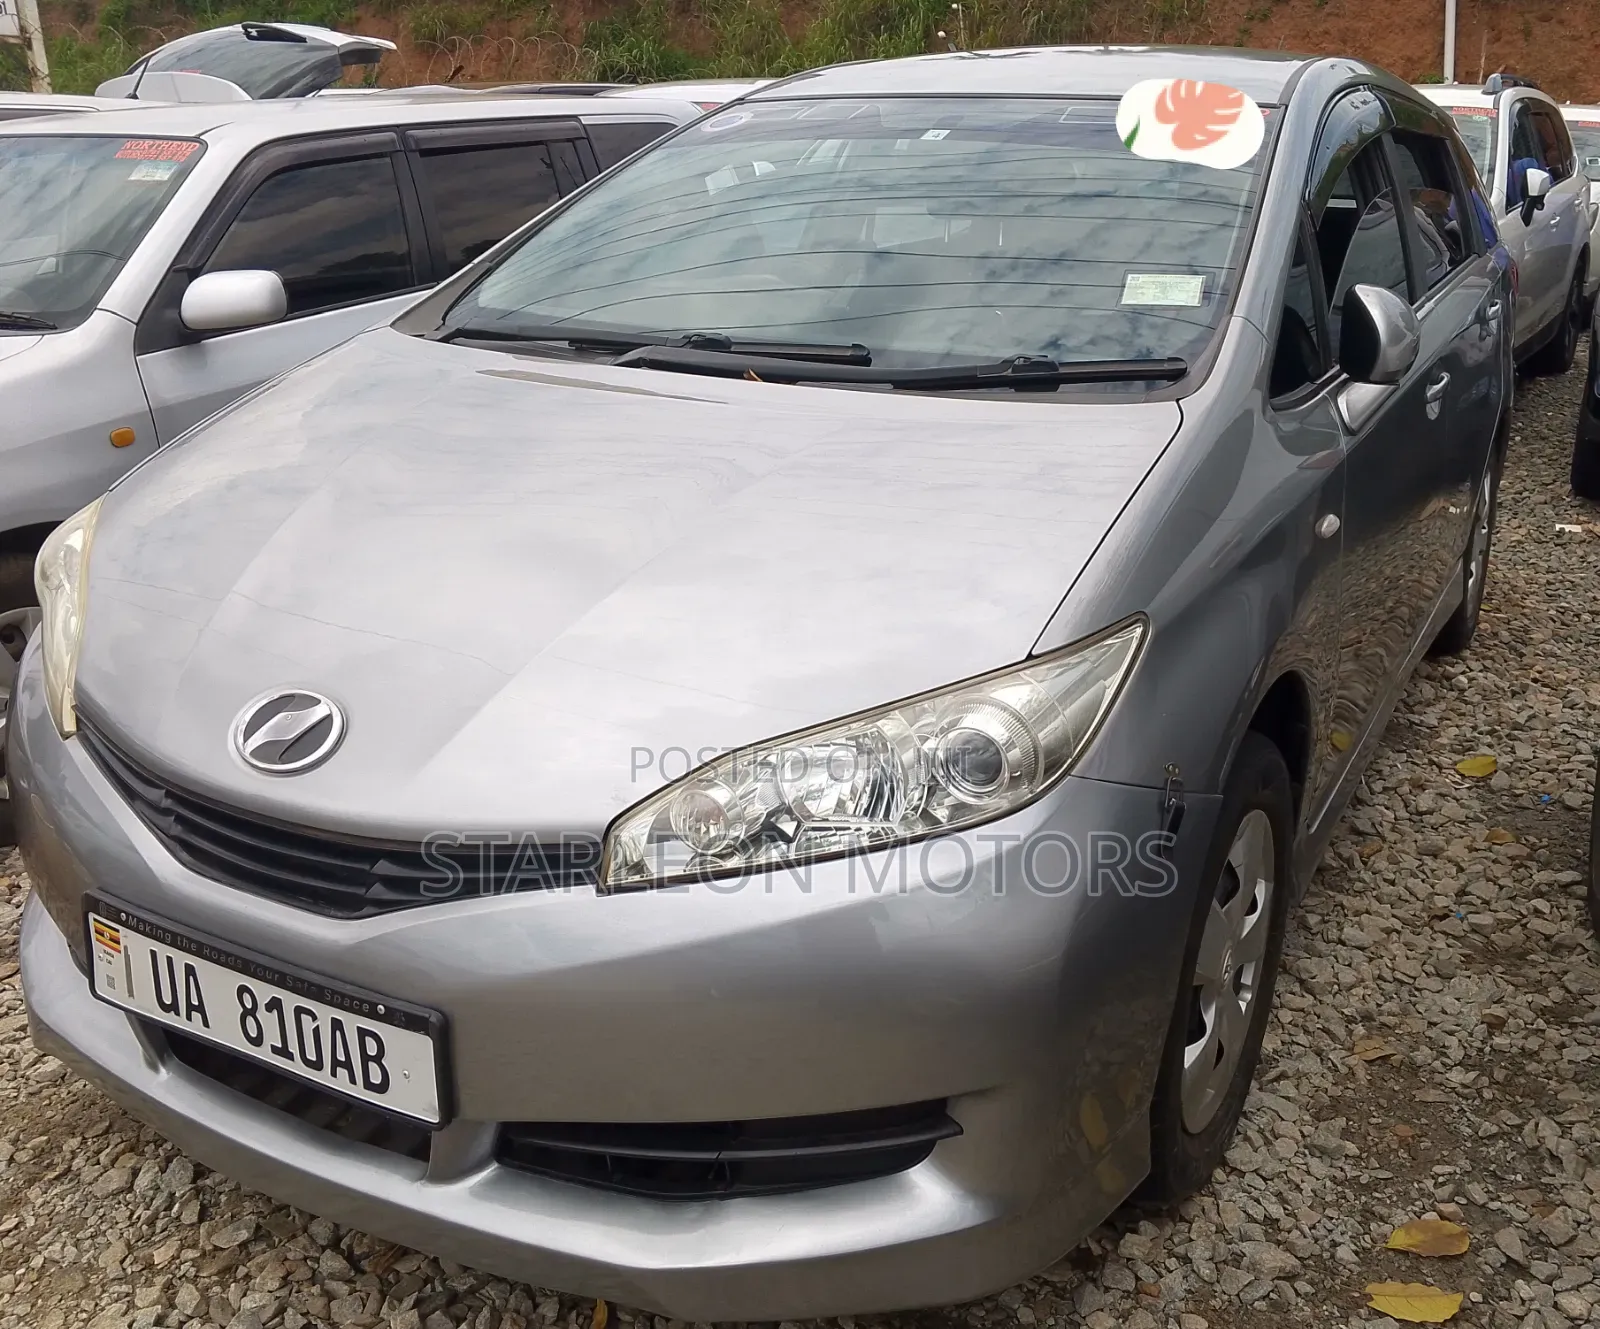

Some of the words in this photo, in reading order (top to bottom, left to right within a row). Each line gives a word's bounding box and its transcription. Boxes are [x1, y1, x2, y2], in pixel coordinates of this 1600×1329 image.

[121, 140, 199, 152] NORTHEND
[128, 915, 171, 943] Making
[177, 935, 197, 951] the
[202, 944, 242, 969] Roads
[250, 964, 280, 982] Your
[324, 989, 370, 1013] Space
[149, 947, 211, 1029] UA
[236, 983, 391, 1095] 810AB
